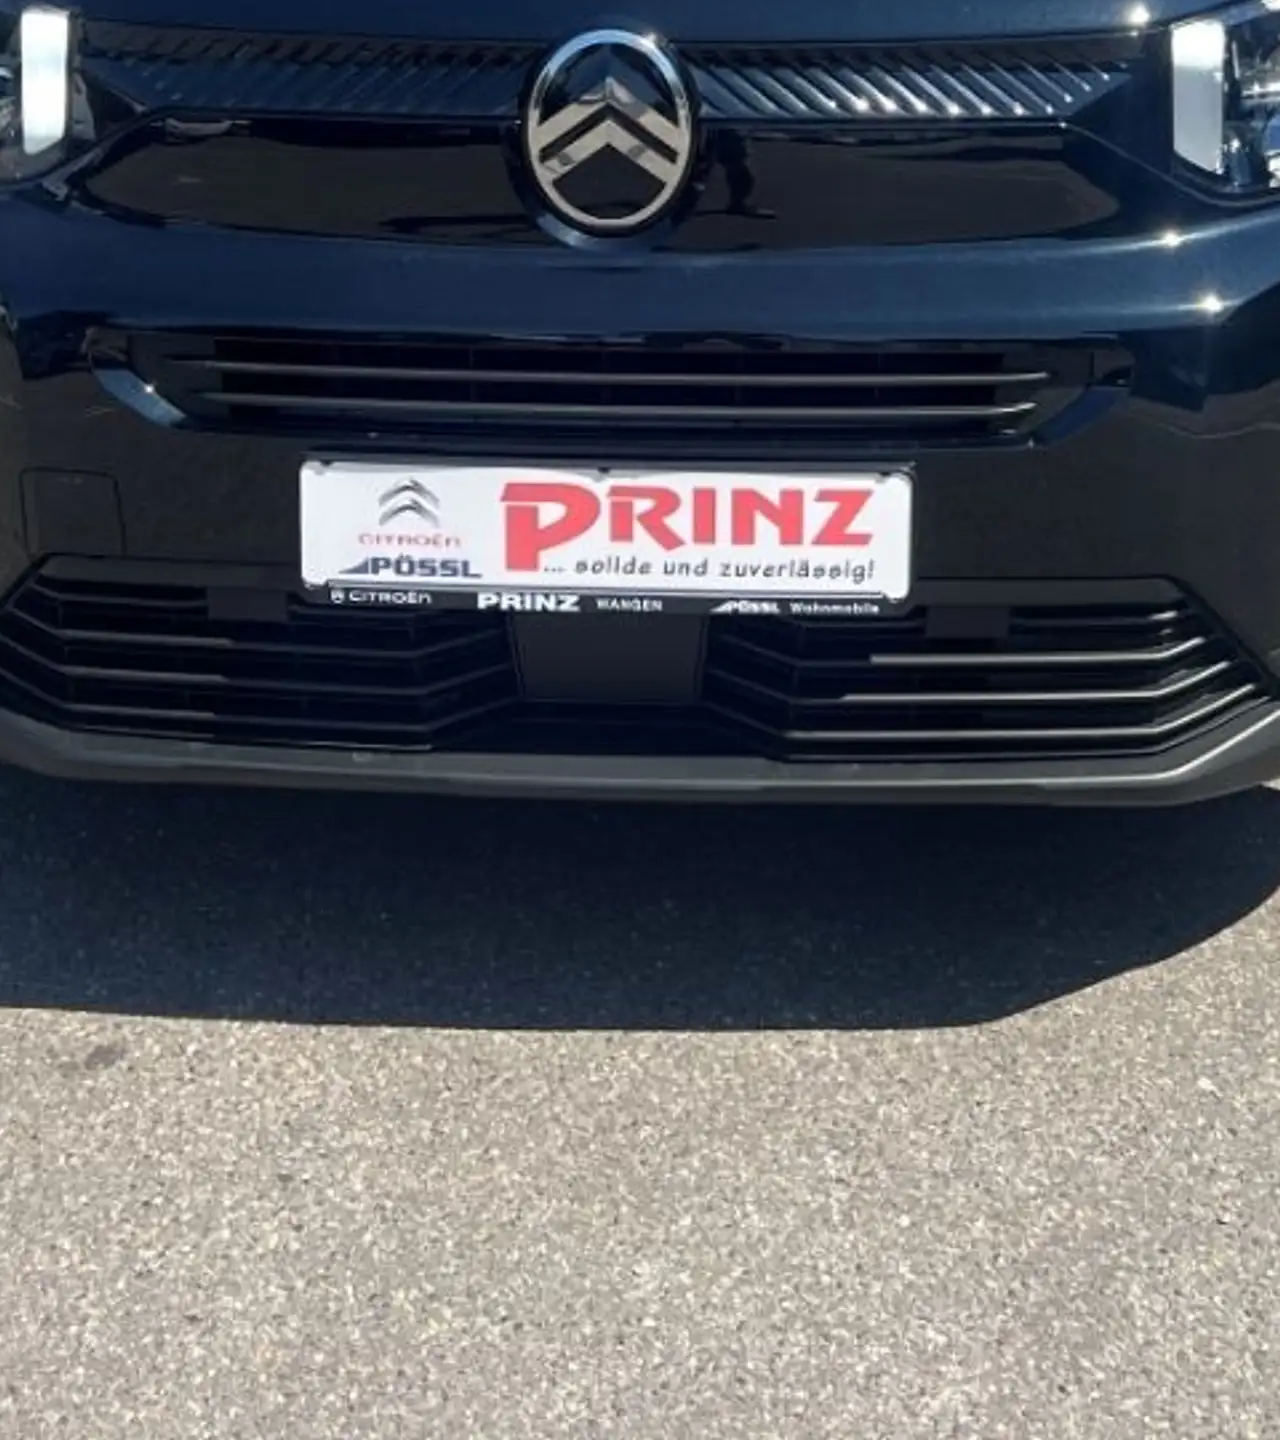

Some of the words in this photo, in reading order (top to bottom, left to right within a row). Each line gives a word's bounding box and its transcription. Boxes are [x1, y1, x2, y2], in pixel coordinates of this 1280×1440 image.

[500, 481, 875, 572] PRINZ
[370, 553, 483, 579] PÖSSL
[575, 556, 651, 575] solide
[663, 558, 708, 577] und
[719, 559, 876, 584] zuverlässig!
[477, 592, 581, 612] PRINZ
